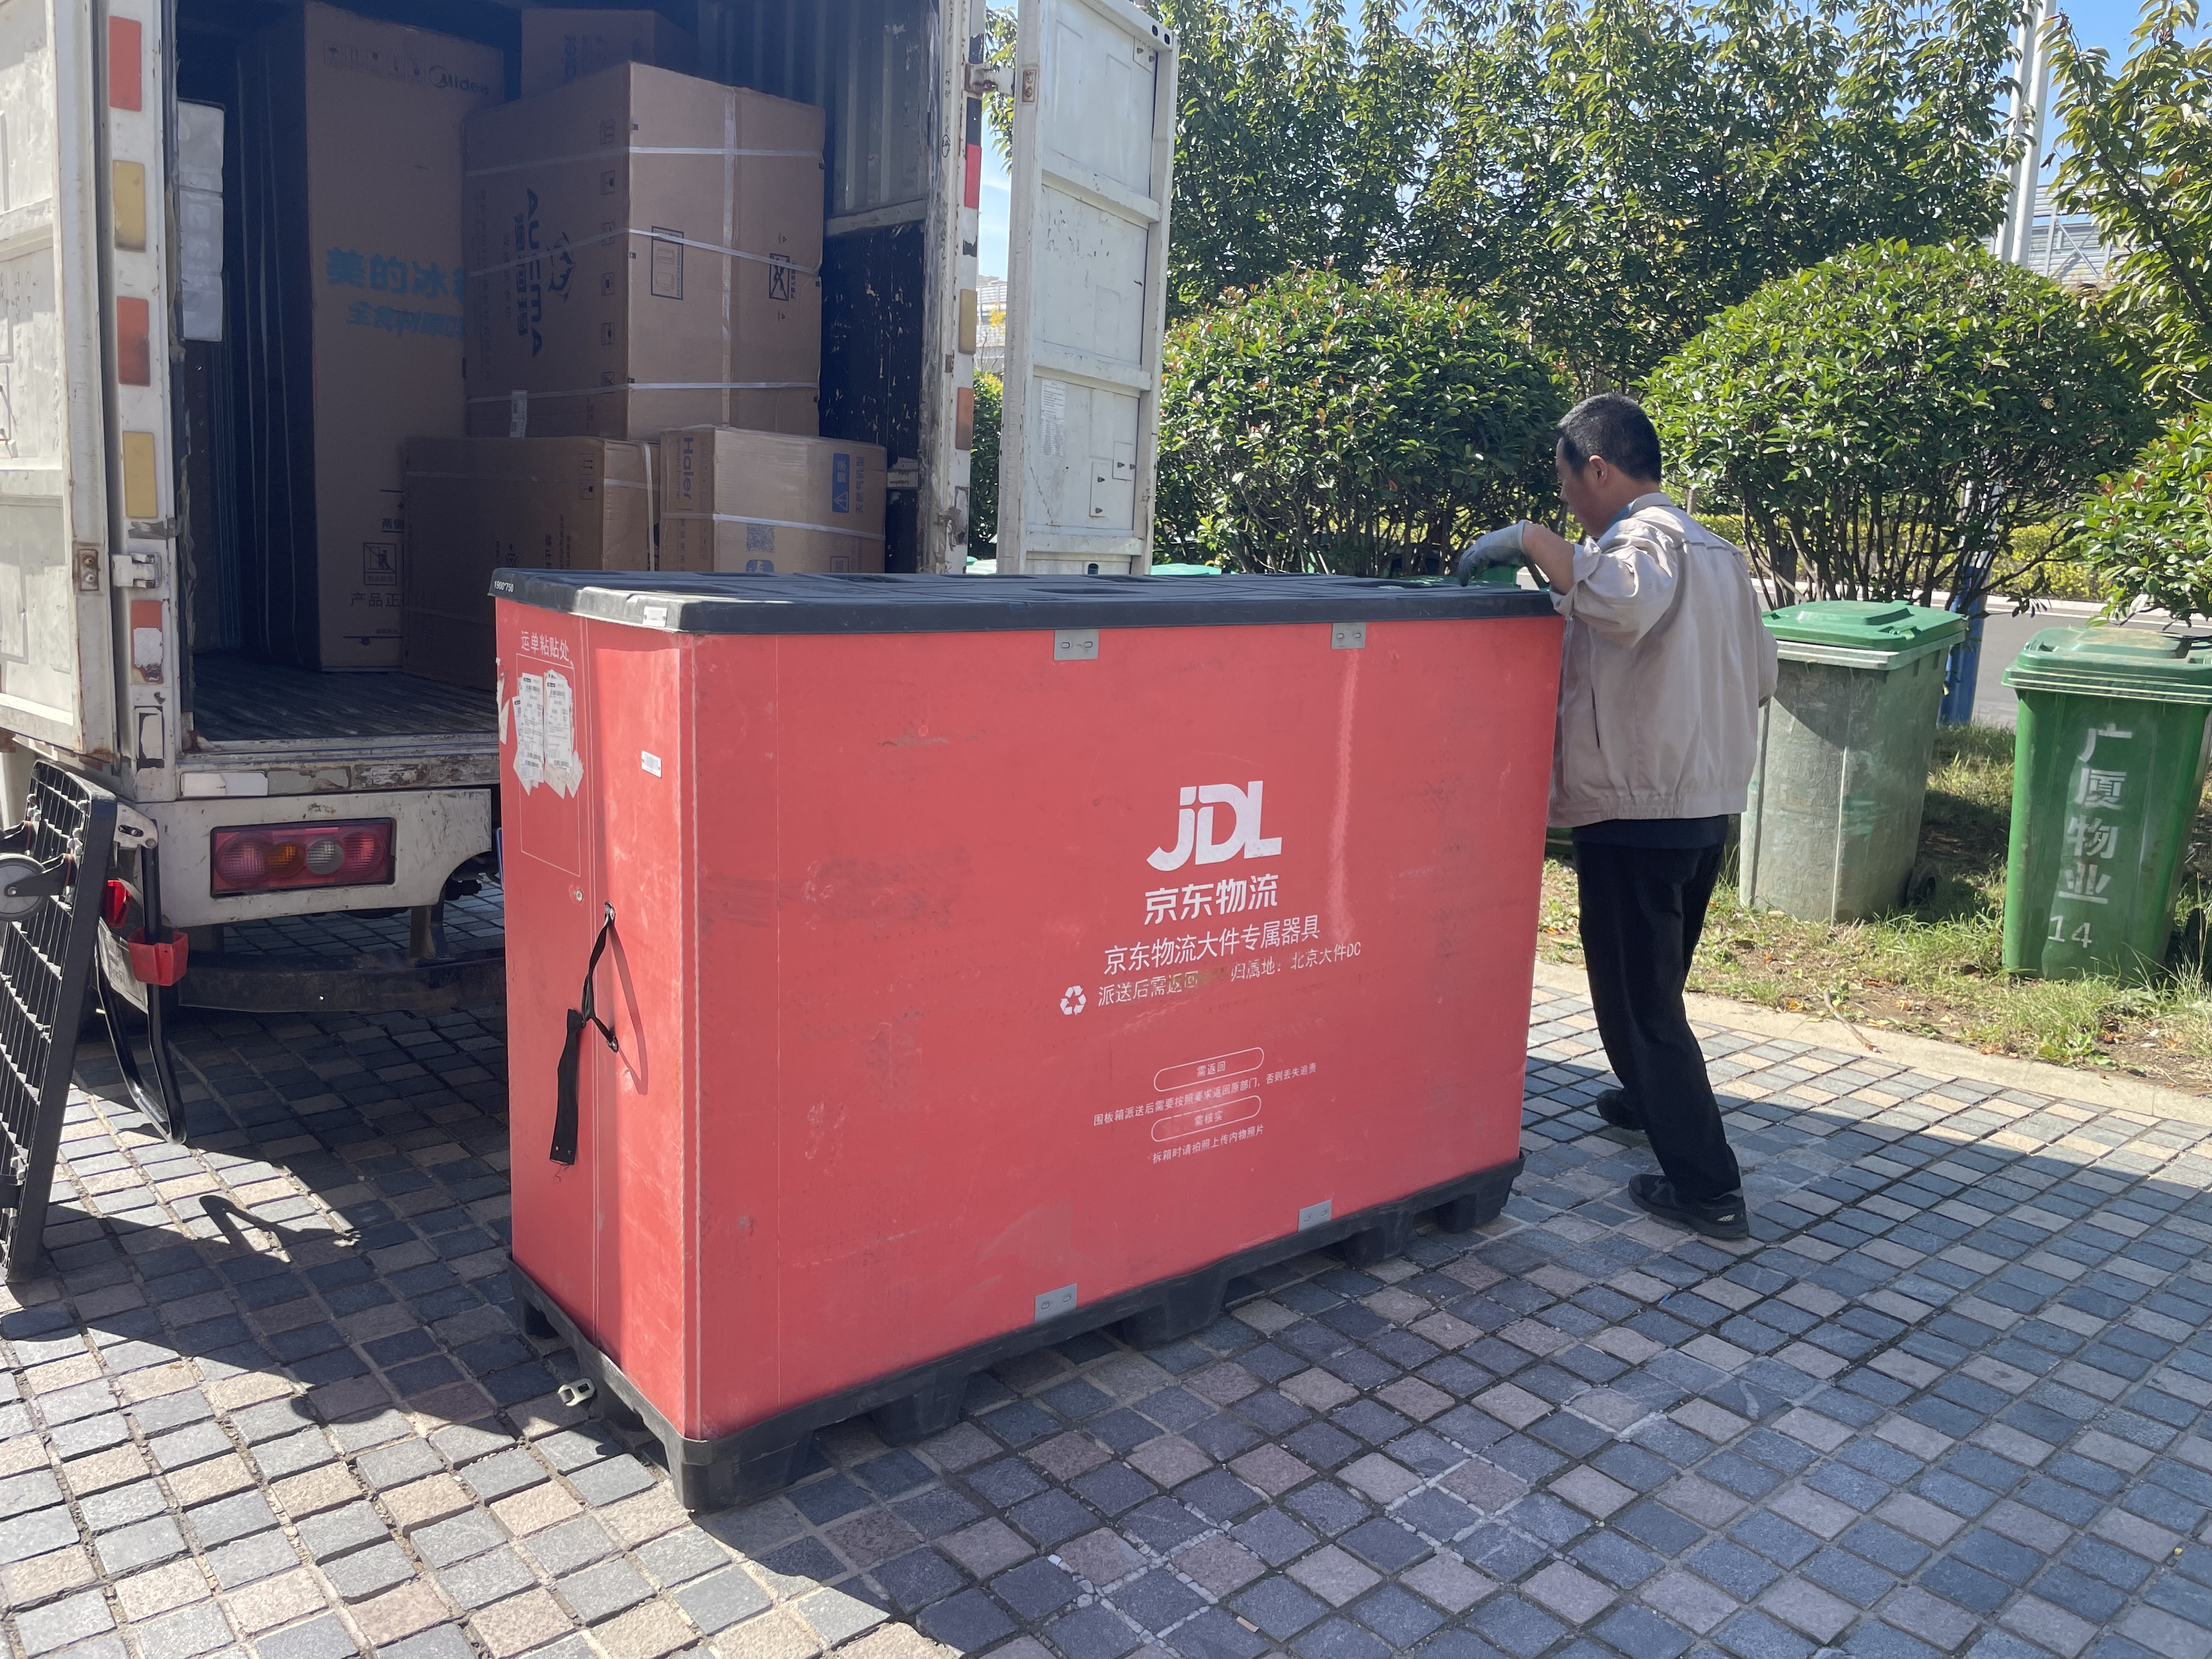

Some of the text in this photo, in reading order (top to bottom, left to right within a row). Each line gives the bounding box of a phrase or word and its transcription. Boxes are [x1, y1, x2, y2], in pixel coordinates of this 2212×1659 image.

[431, 67, 489, 95] Midea
[684, 437, 694, 500] Haier
[837, 459, 847, 483] 警示
[855, 456, 865, 515] 天然气机型
[351, 591, 404, 607] 产品正
[521, 630, 570, 662] 运单粘贴处
[1147, 780, 1282, 871] JDL
[2058, 722, 2134, 904] 广厦物业
[1144, 873, 1279, 926] 京东物流
[1103, 915, 1320, 975] 京东物流大件专属器具
[2047, 915, 2094, 949] 14
[1098, 970, 1199, 1007] 派送后需返回
[1197, 1060, 1226, 1078] 需返回
[1194, 1110, 1223, 1127] 需核实
[1153, 1124, 1264, 1164] 拆箱时请拍照上传内物照片
